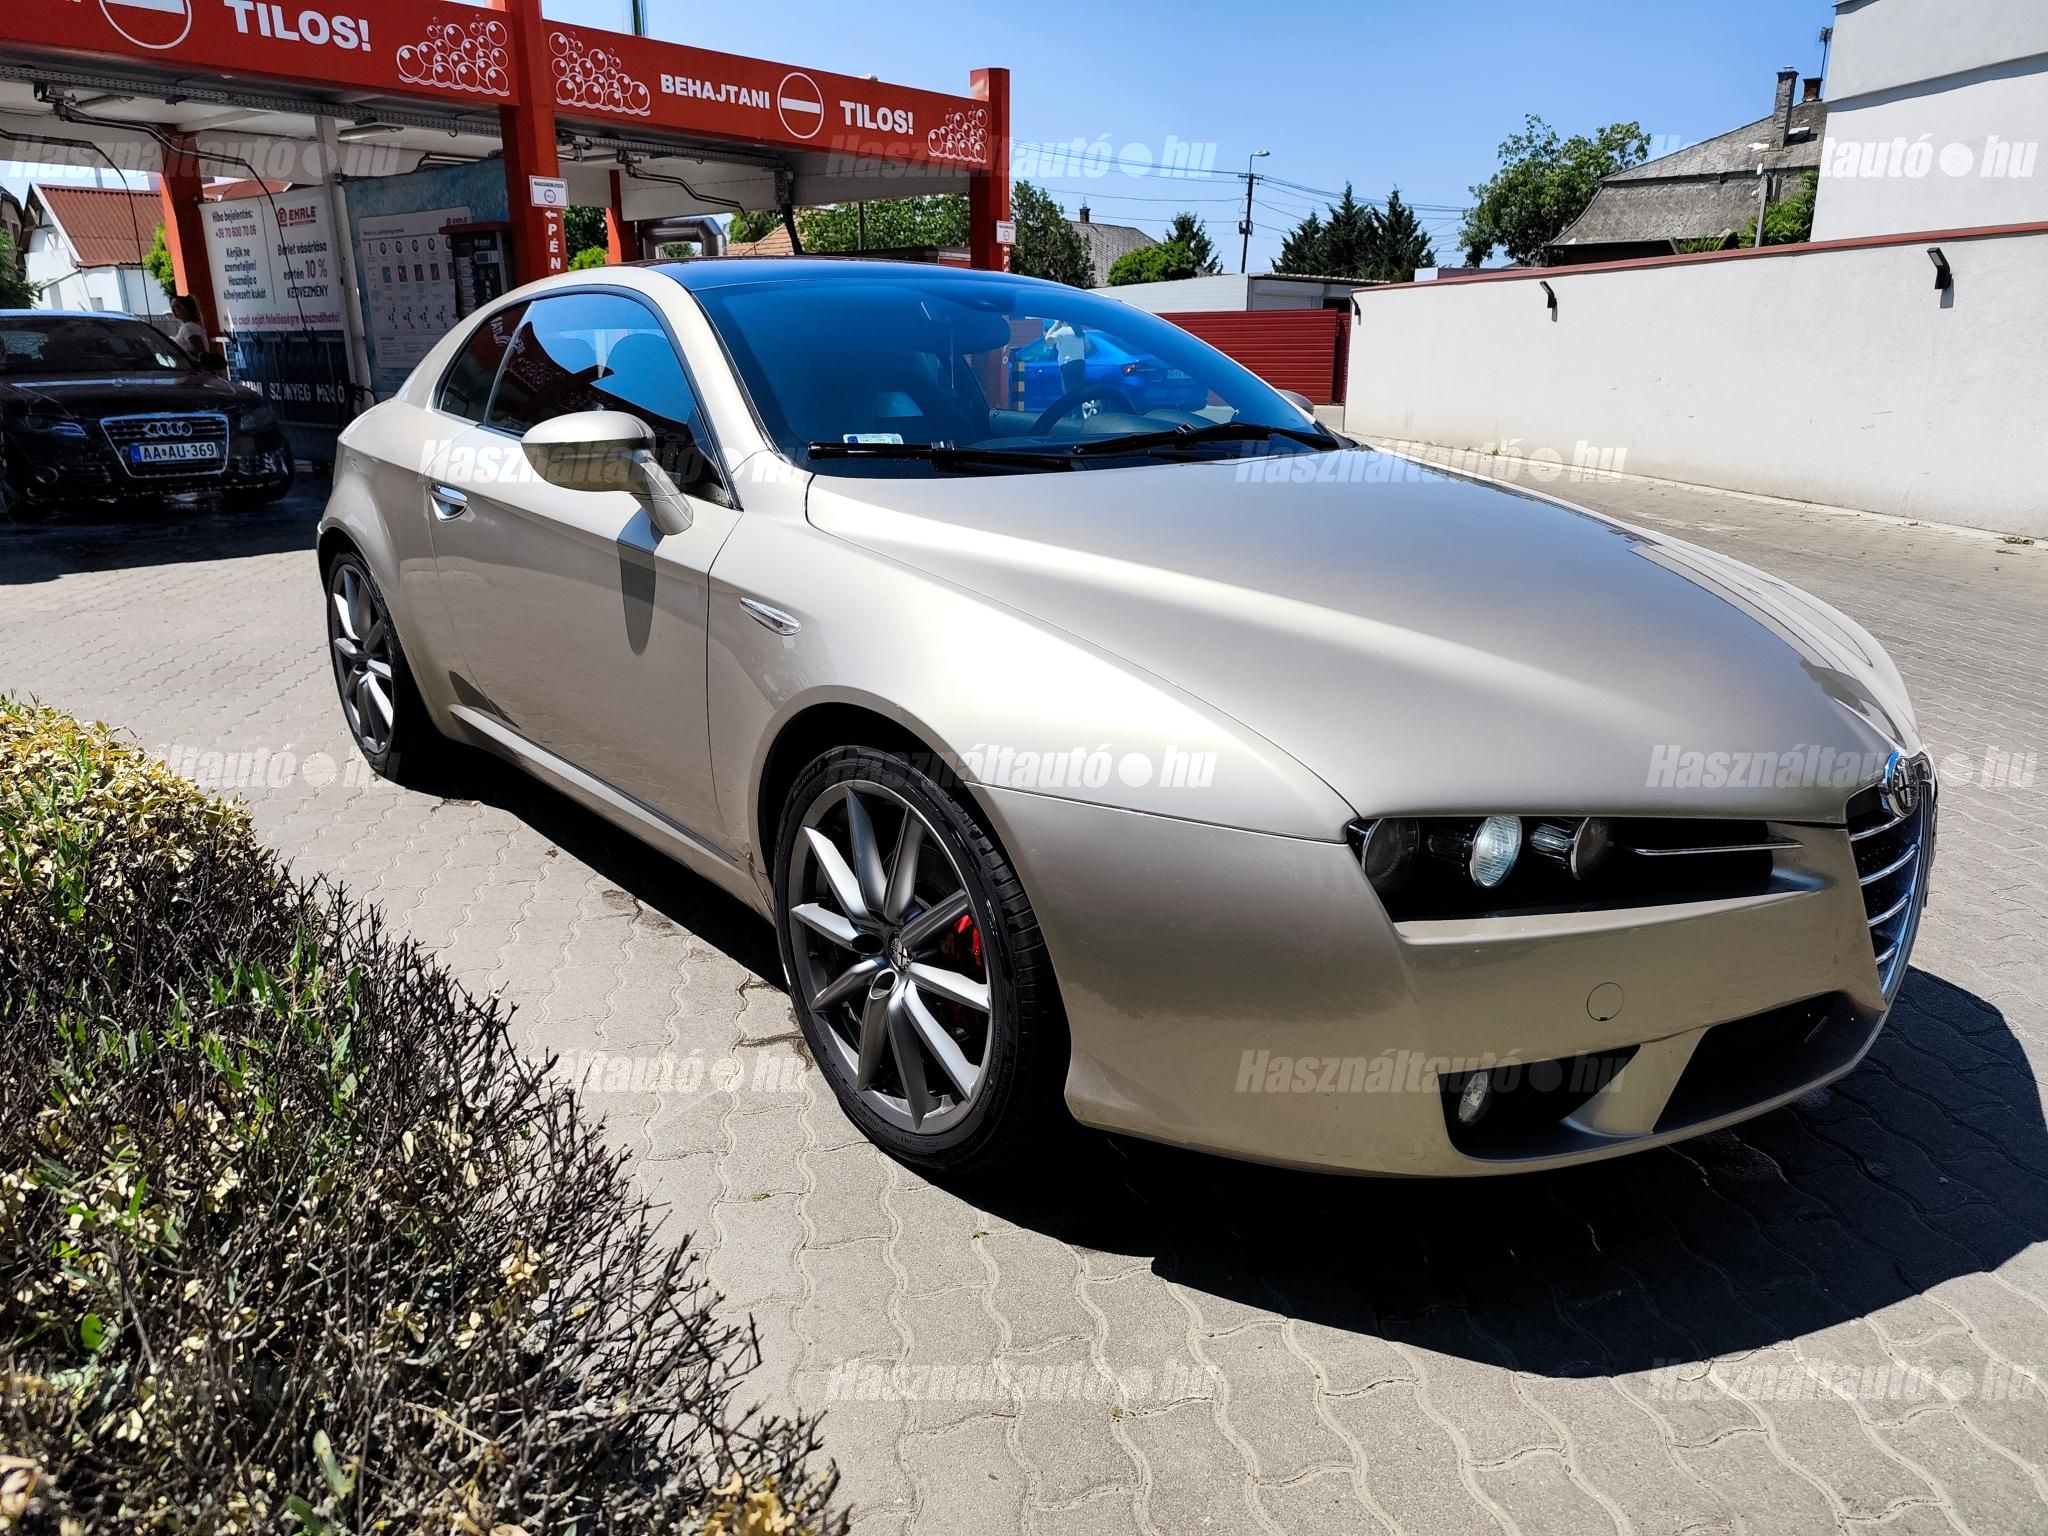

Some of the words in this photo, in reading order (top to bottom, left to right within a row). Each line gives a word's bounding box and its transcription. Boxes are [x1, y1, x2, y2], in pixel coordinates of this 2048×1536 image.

[223, 0, 372, 52] TILOS!
[660, 73, 770, 110] BEHAJTANI
[839, 99, 914, 135] TILOS!
[289, 206, 316, 220] EHRLE
[305, 260, 316, 279] 10
[318, 259, 328, 278] %
